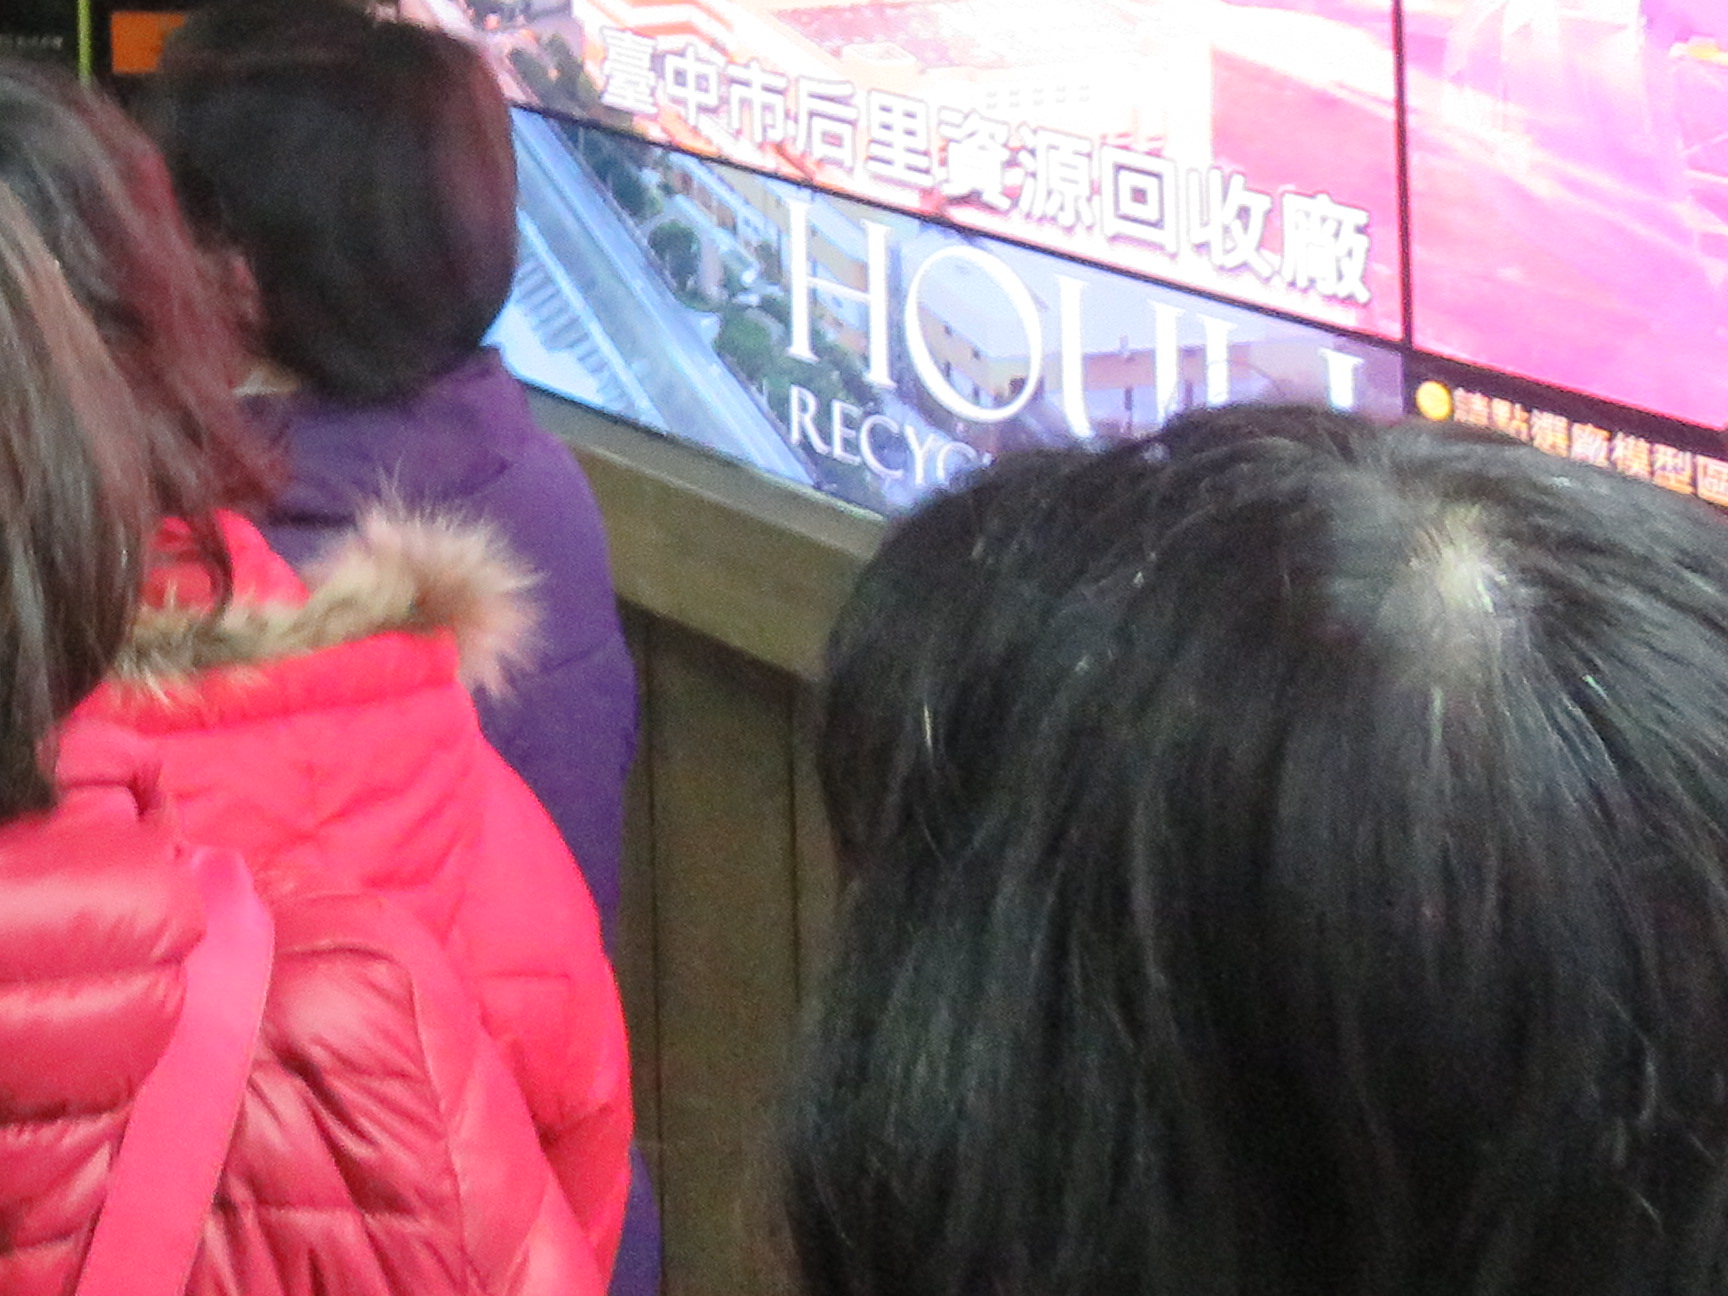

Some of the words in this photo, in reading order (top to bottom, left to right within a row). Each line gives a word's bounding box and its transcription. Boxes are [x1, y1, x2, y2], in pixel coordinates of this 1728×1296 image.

[600, 25, 1372, 305] 臺中市后里資源回收廠
[788, 383, 994, 488] RECYC
